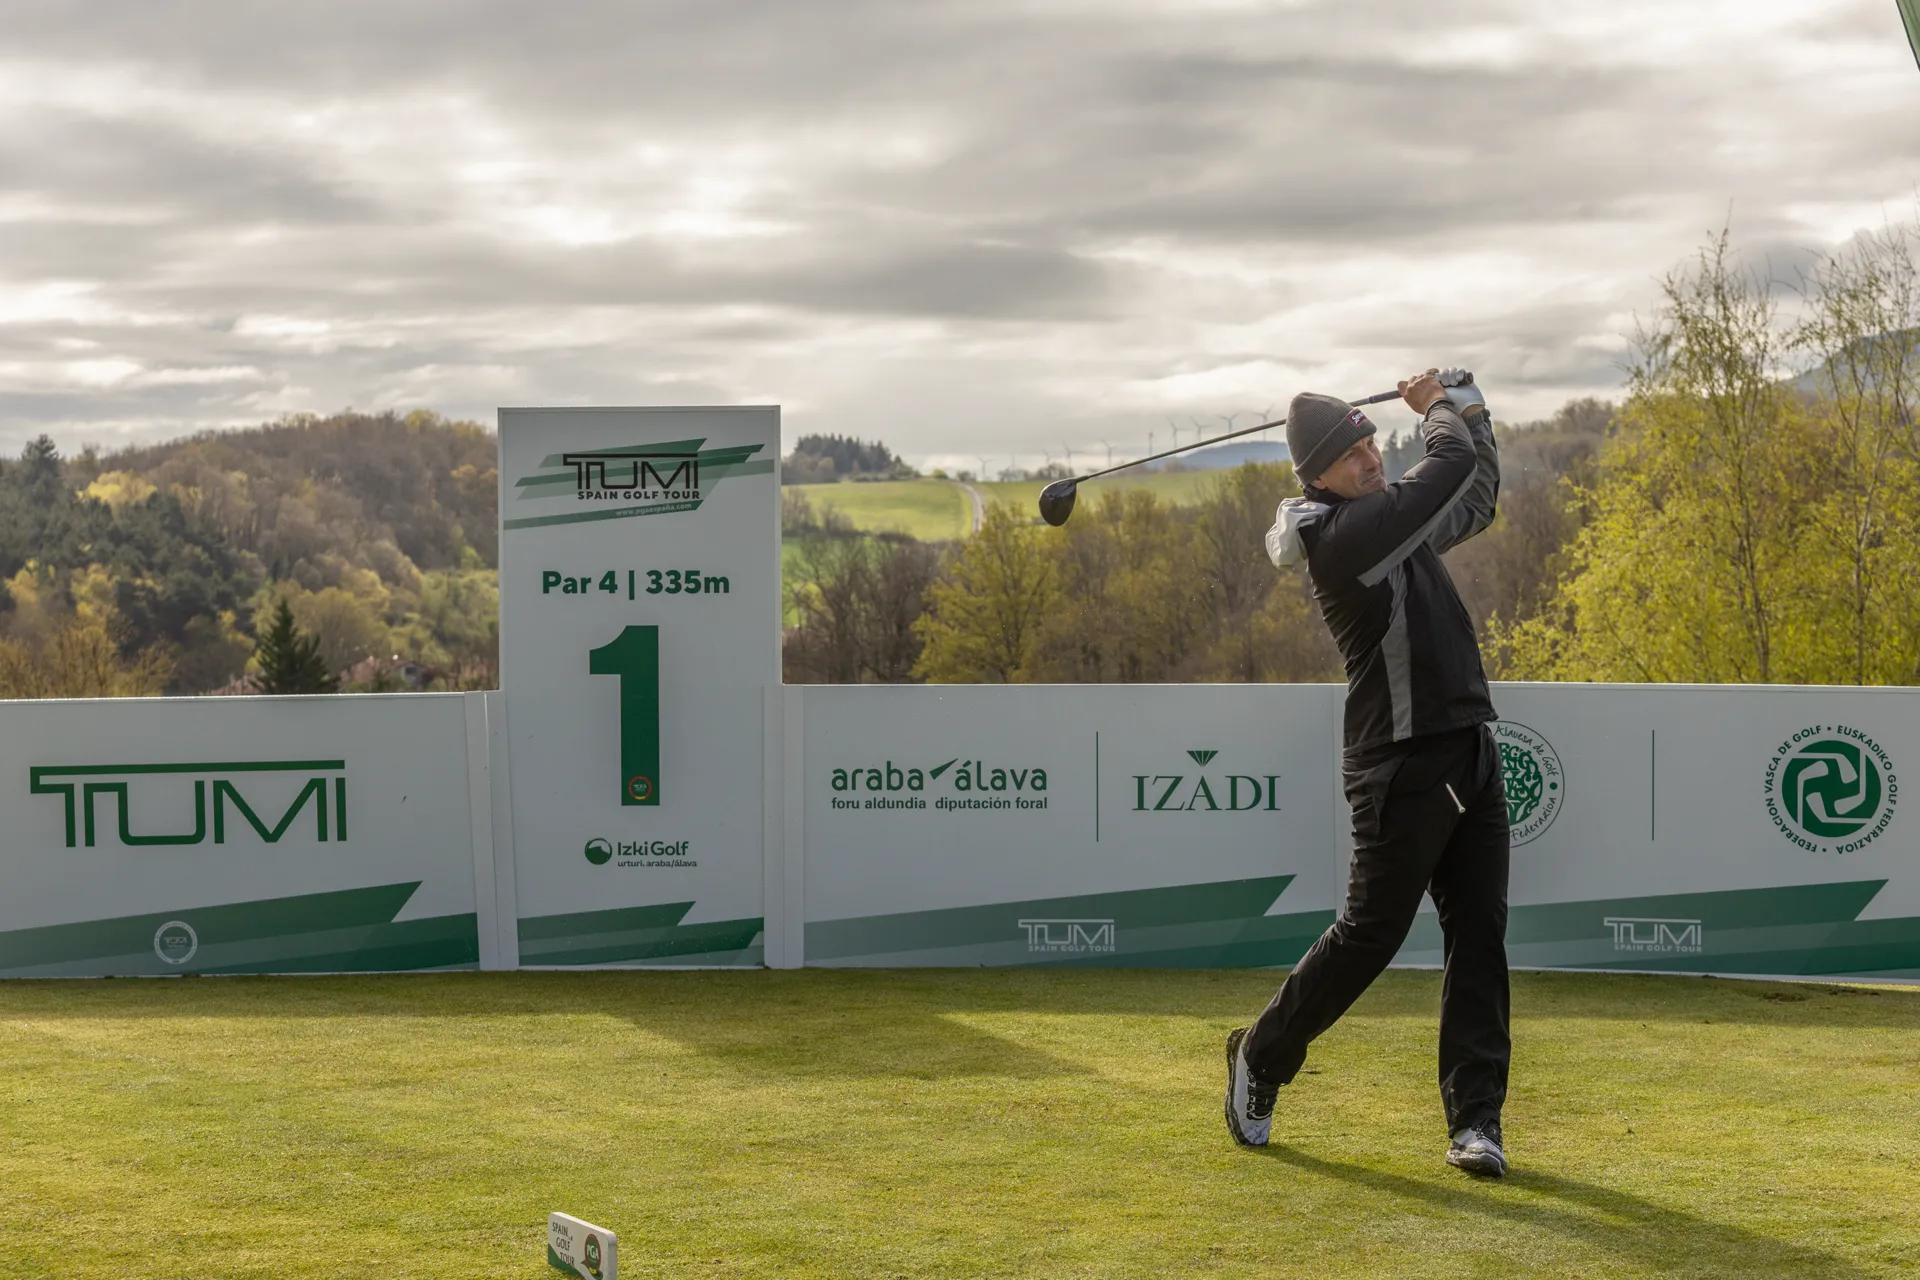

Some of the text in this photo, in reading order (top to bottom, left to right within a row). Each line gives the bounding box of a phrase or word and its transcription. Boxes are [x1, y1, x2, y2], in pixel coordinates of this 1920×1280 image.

[563, 453, 698, 489] TUMI
[578, 490, 701, 500] SPAIN GOLF TOUR
[542, 571, 592, 594] Par
[598, 571, 618, 594] 4
[645, 570, 730, 594] 335m
[590, 625, 660, 806] 1
[1533, 743, 1545, 756] de
[1542, 756, 1559, 777] Golf
[831, 760, 1047, 791] araba álava
[1764, 725, 1822, 853] FEDERACION VASCA DE GOLF
[1131, 774, 1282, 811] IZADI
[1836, 725, 1898, 854] EUSKADIKO GOLF FEDERAZIOA
[30, 759, 347, 848] TUMI
[832, 797, 1048, 812] foru aldundia diputación foral
[1511, 797, 1557, 841] Federazioa
[646, 859, 697, 868] araba/álava
[1018, 919, 1115, 945] TUMI
[1603, 917, 1702, 946] TUMI
[1675, 945, 1702, 953] TOUR
[552, 1221, 569, 1237] SPAIN
[555, 1237, 571, 1251] GOLF
[586, 1244, 600, 1260] PGA
[560, 1252, 575, 1267] TOUR
